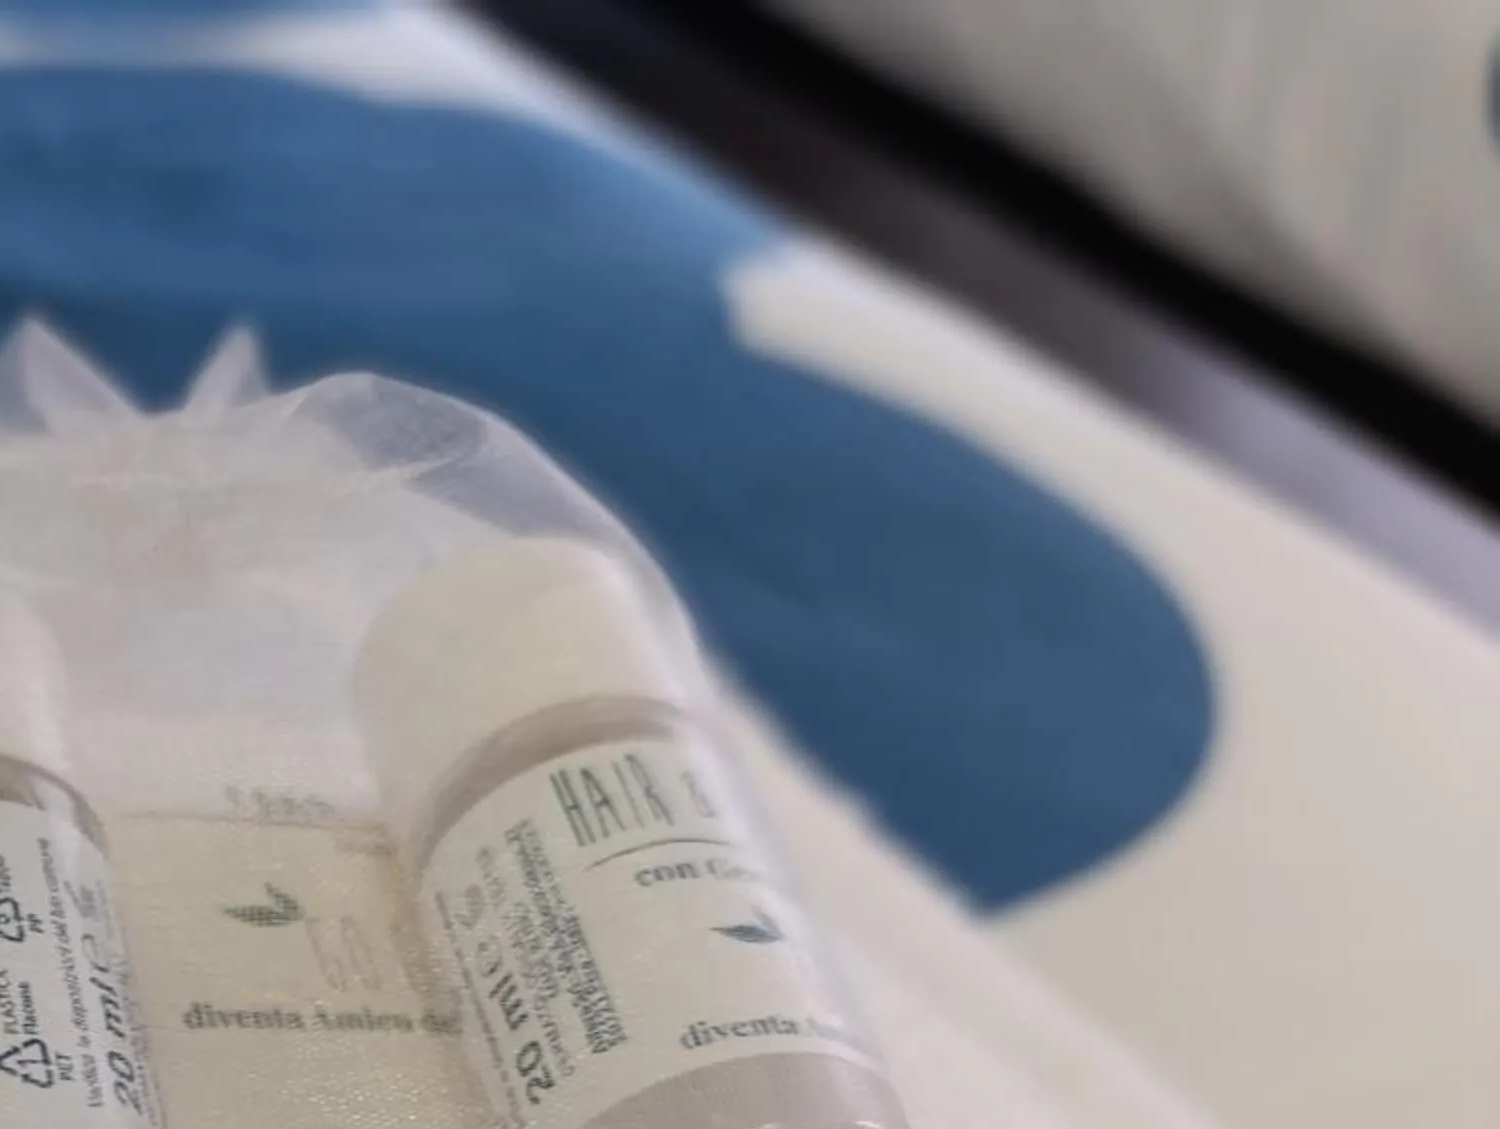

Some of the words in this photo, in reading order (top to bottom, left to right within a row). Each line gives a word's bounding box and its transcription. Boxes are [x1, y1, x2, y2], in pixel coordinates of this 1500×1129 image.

[549, 752, 675, 848] HAIR
[634, 862, 700, 887] con
[183, 1002, 305, 1032] diventa
[488, 971, 529, 1032] ml
[679, 1015, 801, 1050] diventa
[106, 1051, 143, 1116] 20
[515, 1040, 556, 1106] 20
